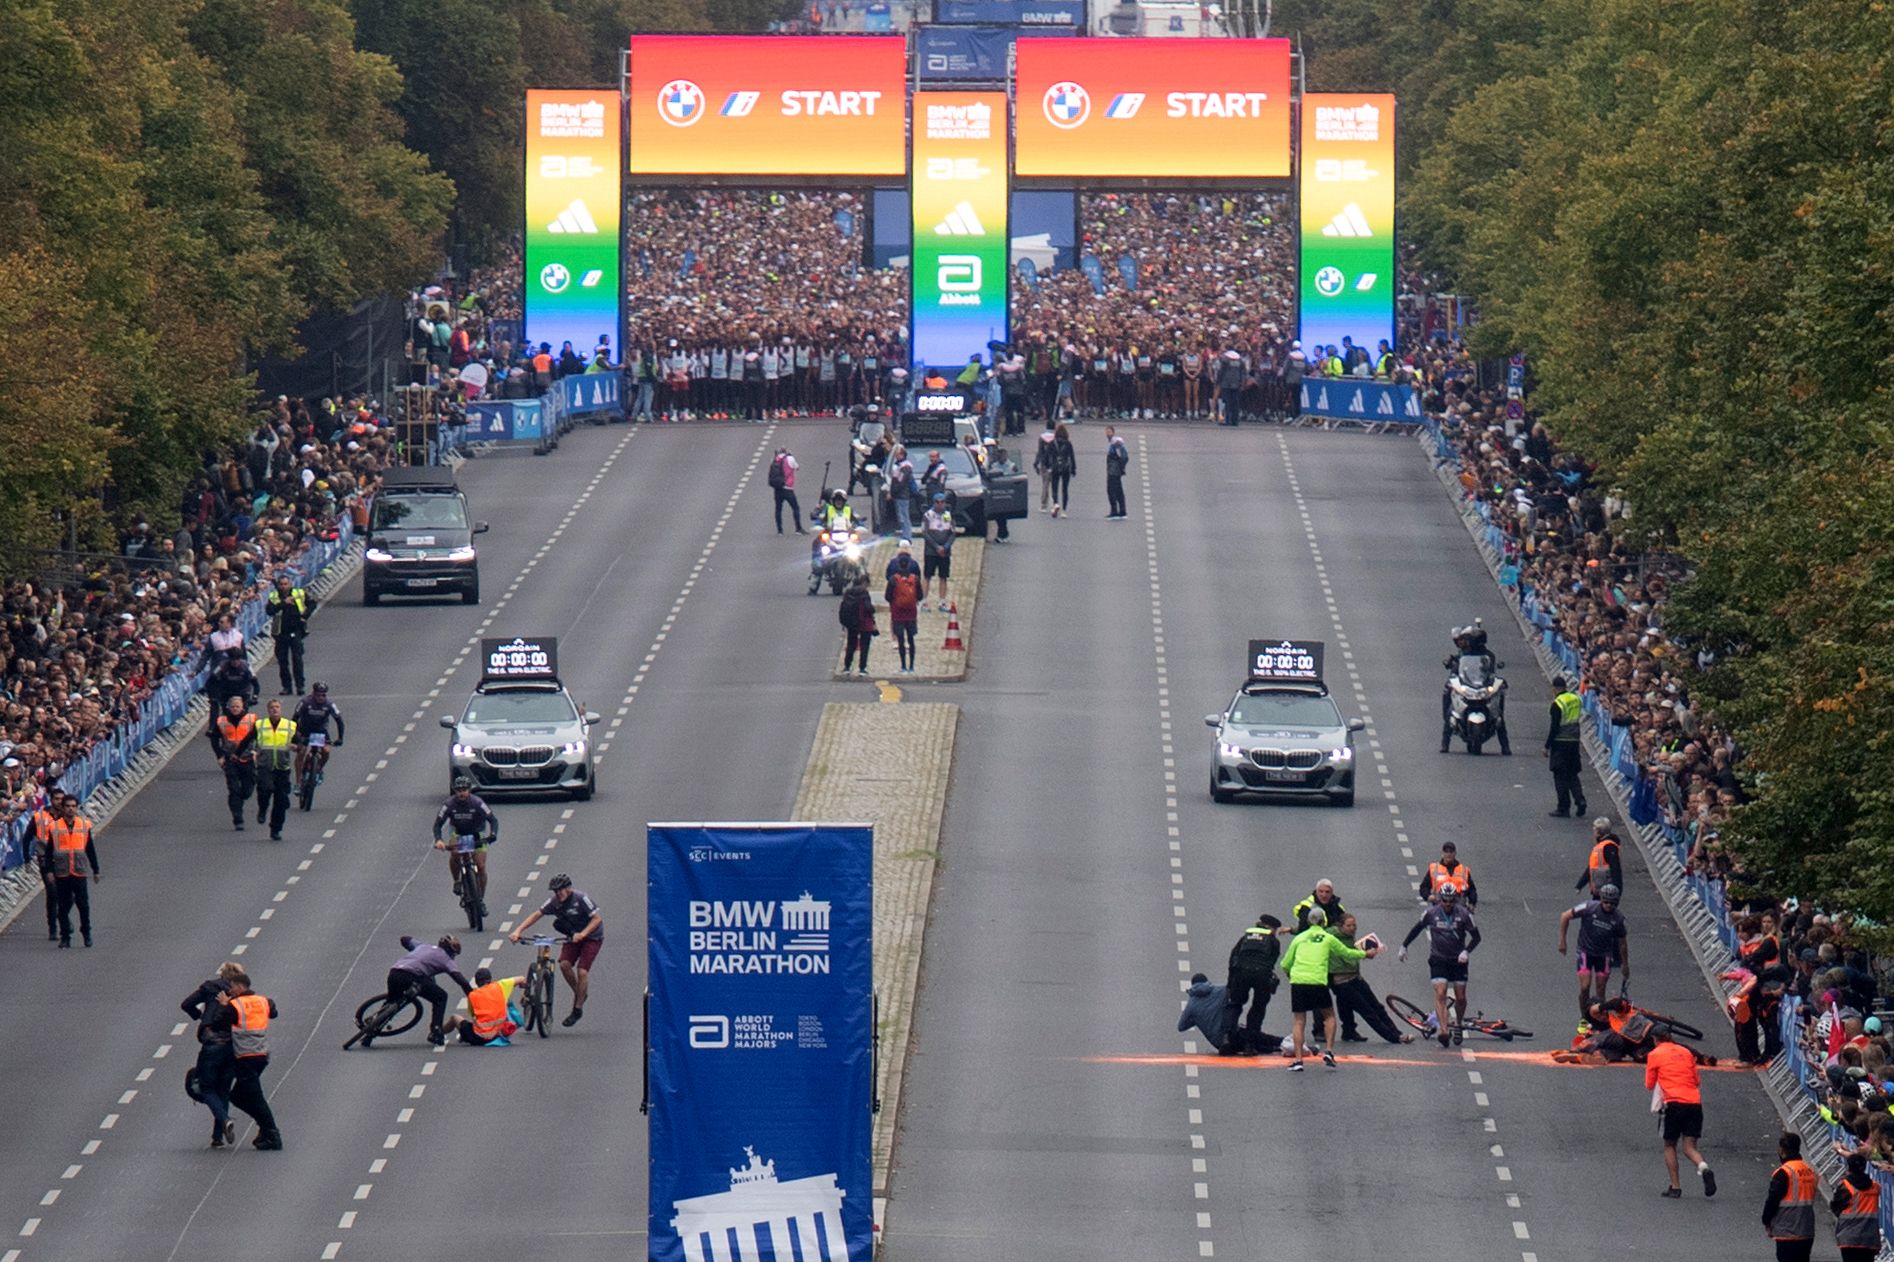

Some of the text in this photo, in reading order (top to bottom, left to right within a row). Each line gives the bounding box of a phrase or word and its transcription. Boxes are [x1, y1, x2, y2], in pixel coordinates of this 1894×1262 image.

[781, 90, 881, 116] START
[1167, 92, 1267, 118] START
[491, 652, 547, 666] 00:00:00
[1257, 654, 1314, 669] 00:00:00
[713, 852, 751, 860] EVENTS
[689, 901, 775, 928] BMW
[689, 931, 776, 951] BERLIN
[690, 954, 830, 974] MARATHON
[734, 1032, 793, 1040] MARATHON
[734, 1040, 777, 1048] MAJORS
